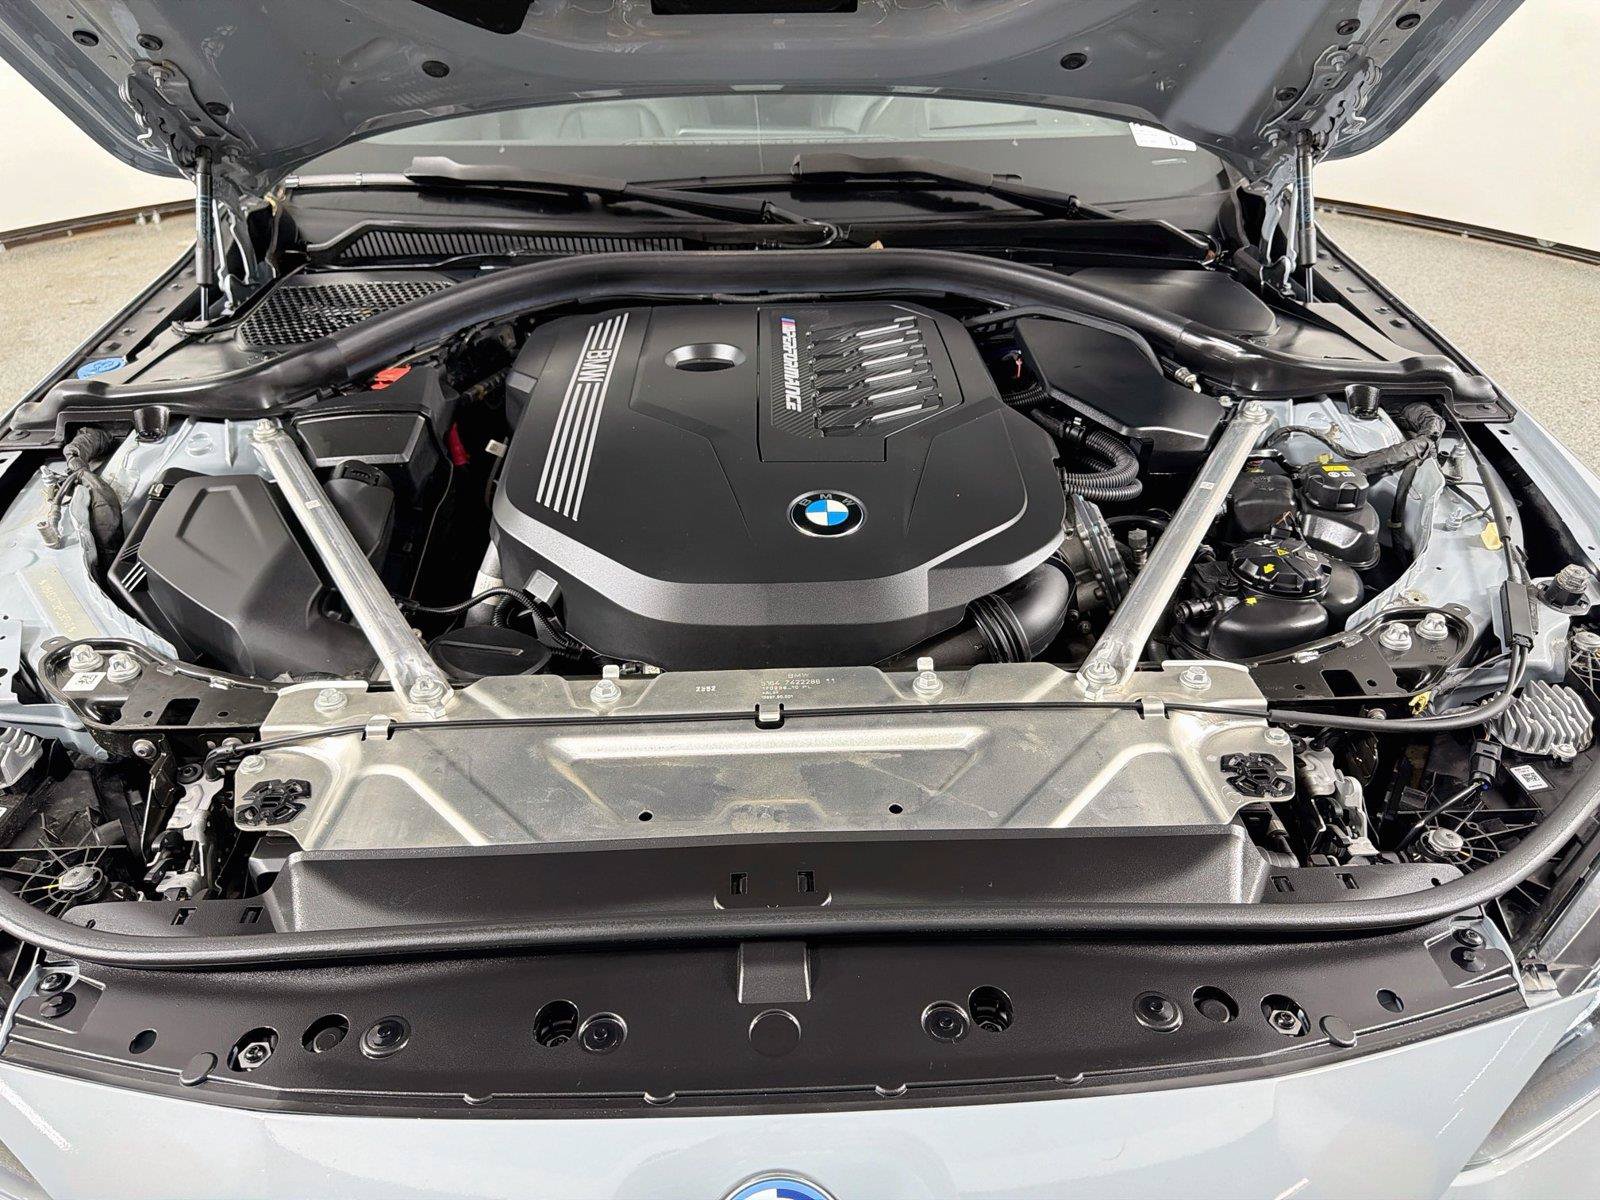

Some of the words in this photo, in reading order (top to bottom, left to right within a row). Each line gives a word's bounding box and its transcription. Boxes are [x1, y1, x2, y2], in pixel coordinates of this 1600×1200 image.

[578, 350, 612, 382] BMW
[782, 331, 802, 413] PERFORMANCE
[799, 493, 855, 507] BMW
